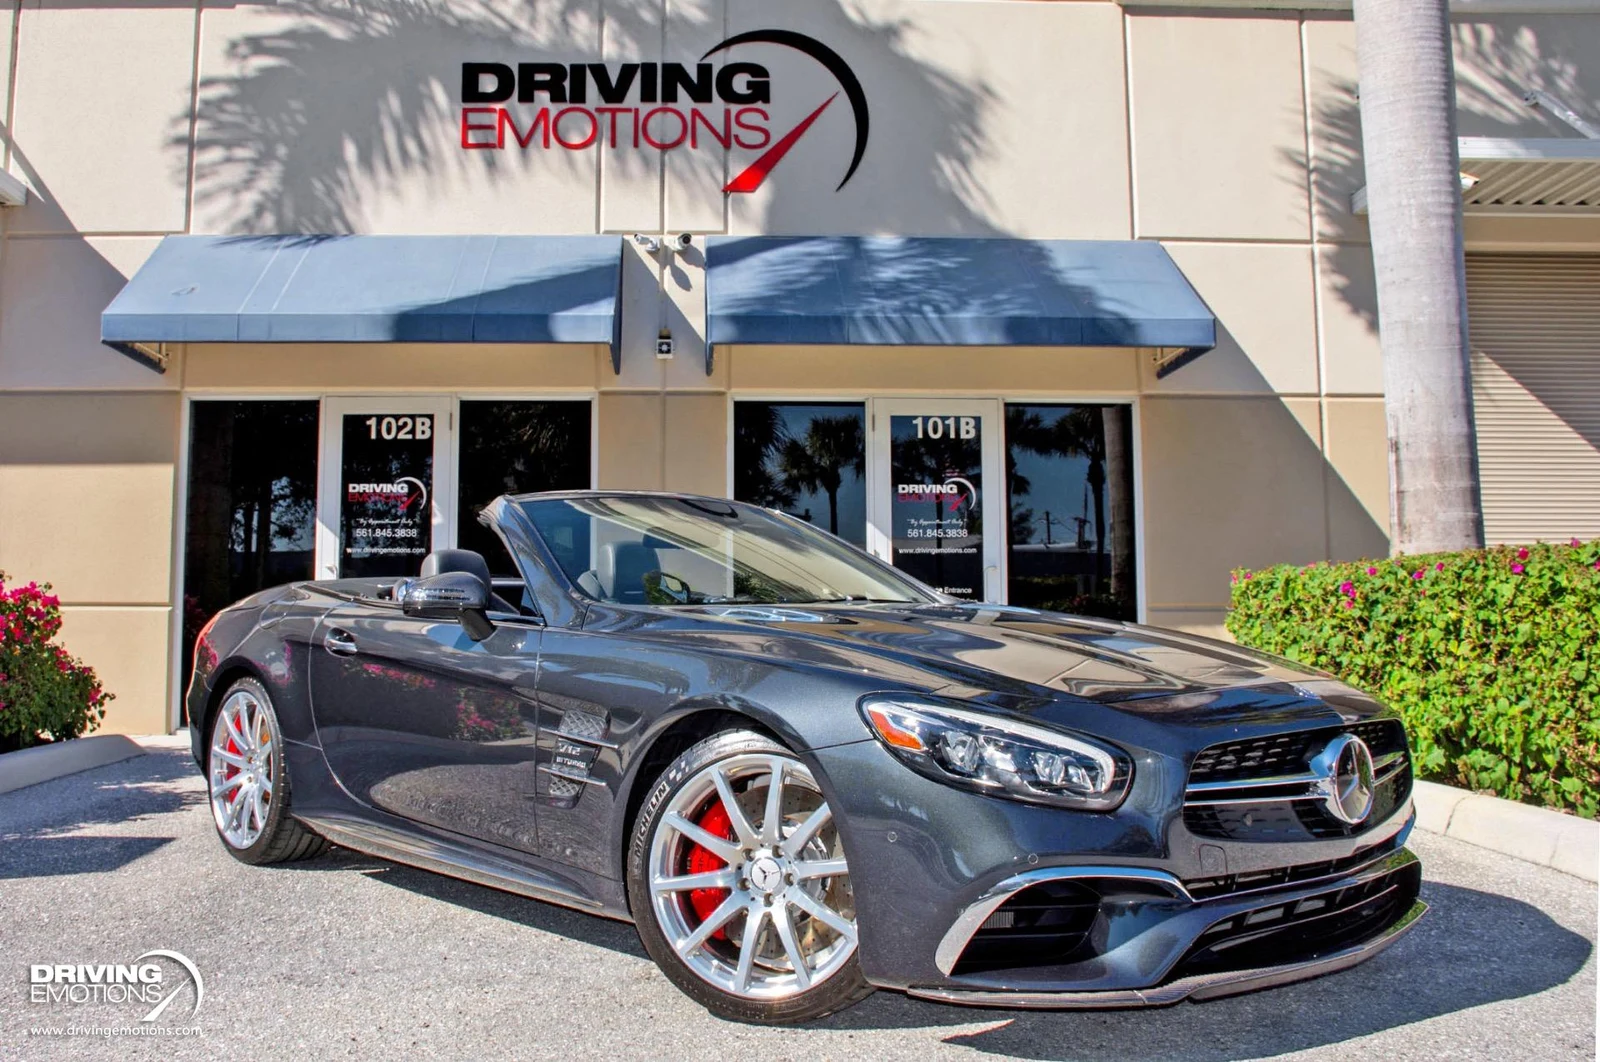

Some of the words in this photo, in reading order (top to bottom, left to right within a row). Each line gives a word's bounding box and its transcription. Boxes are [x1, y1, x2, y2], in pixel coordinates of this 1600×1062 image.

[461, 62, 770, 104] DRIVING
[461, 106, 771, 150] EMOTIONS
[366, 416, 432, 440] 102B
[912, 416, 976, 440] 101B
[348, 483, 408, 493] DRIVING
[897, 484, 958, 494] DRIVING
[356, 528, 417, 538] 561.845.3838
[907, 528, 968, 538] 561.845.3838
[346, 547, 426, 555] www.drivingemotions.com
[898, 547, 977, 555] www.drivingemotions.com
[943, 586, 973, 594] Entrance
[634, 781, 670, 858] MICHELIN
